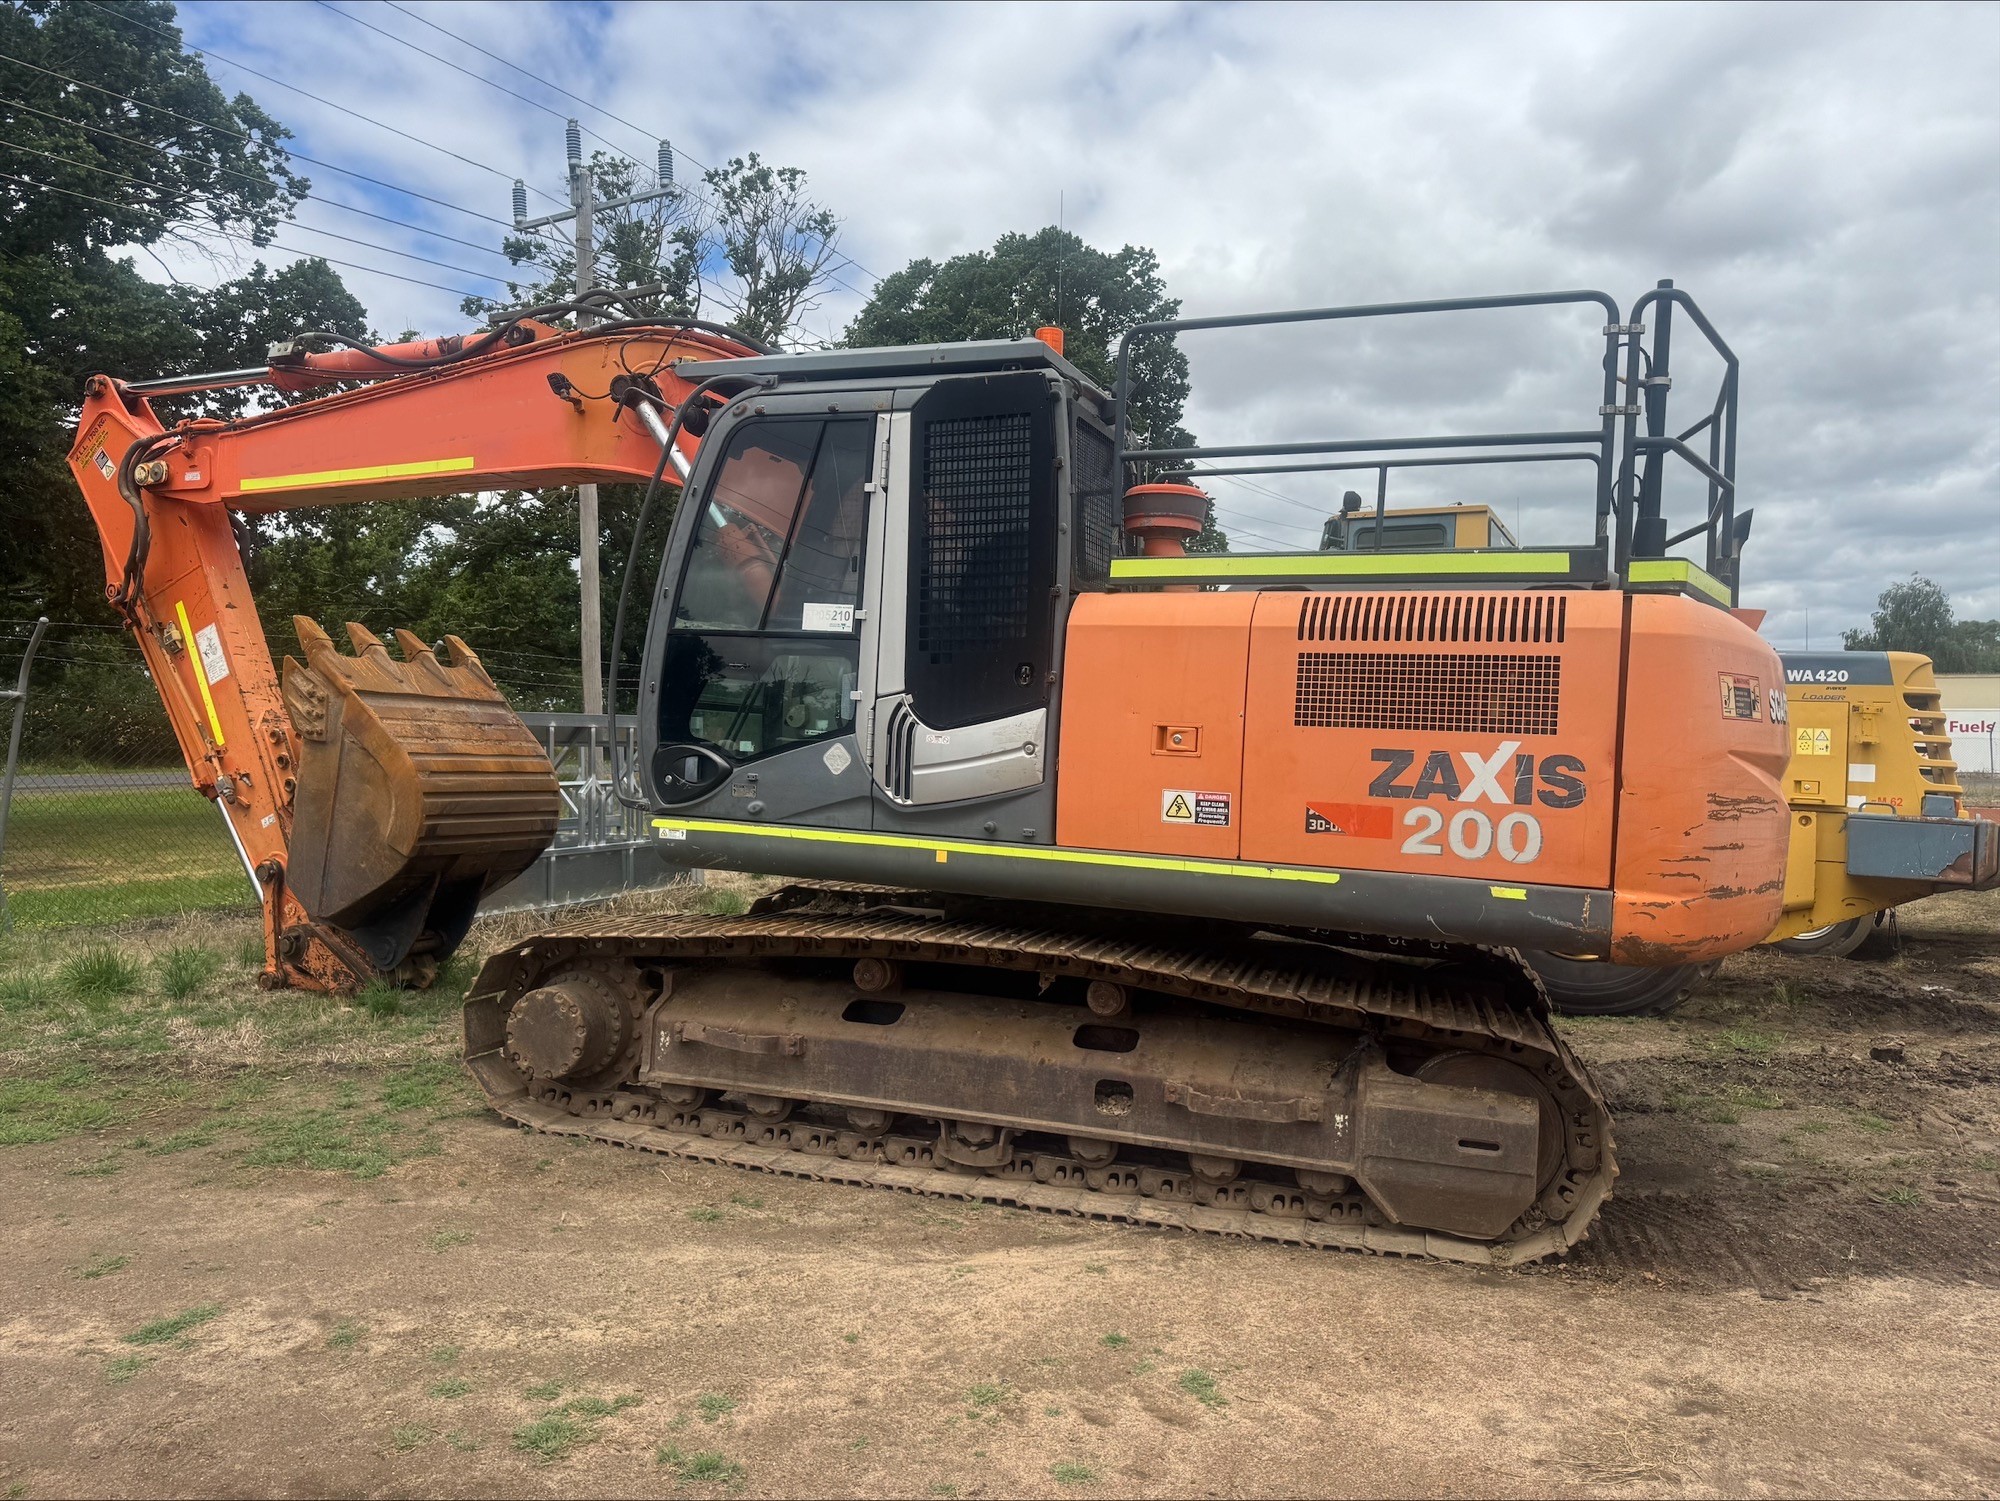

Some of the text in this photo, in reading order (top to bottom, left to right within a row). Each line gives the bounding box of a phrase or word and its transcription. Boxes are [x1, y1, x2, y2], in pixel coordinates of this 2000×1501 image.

[1949, 720, 1995, 733] Fuels
[1369, 741, 1587, 809] ZAXIS
[1400, 806, 1544, 864] 200
